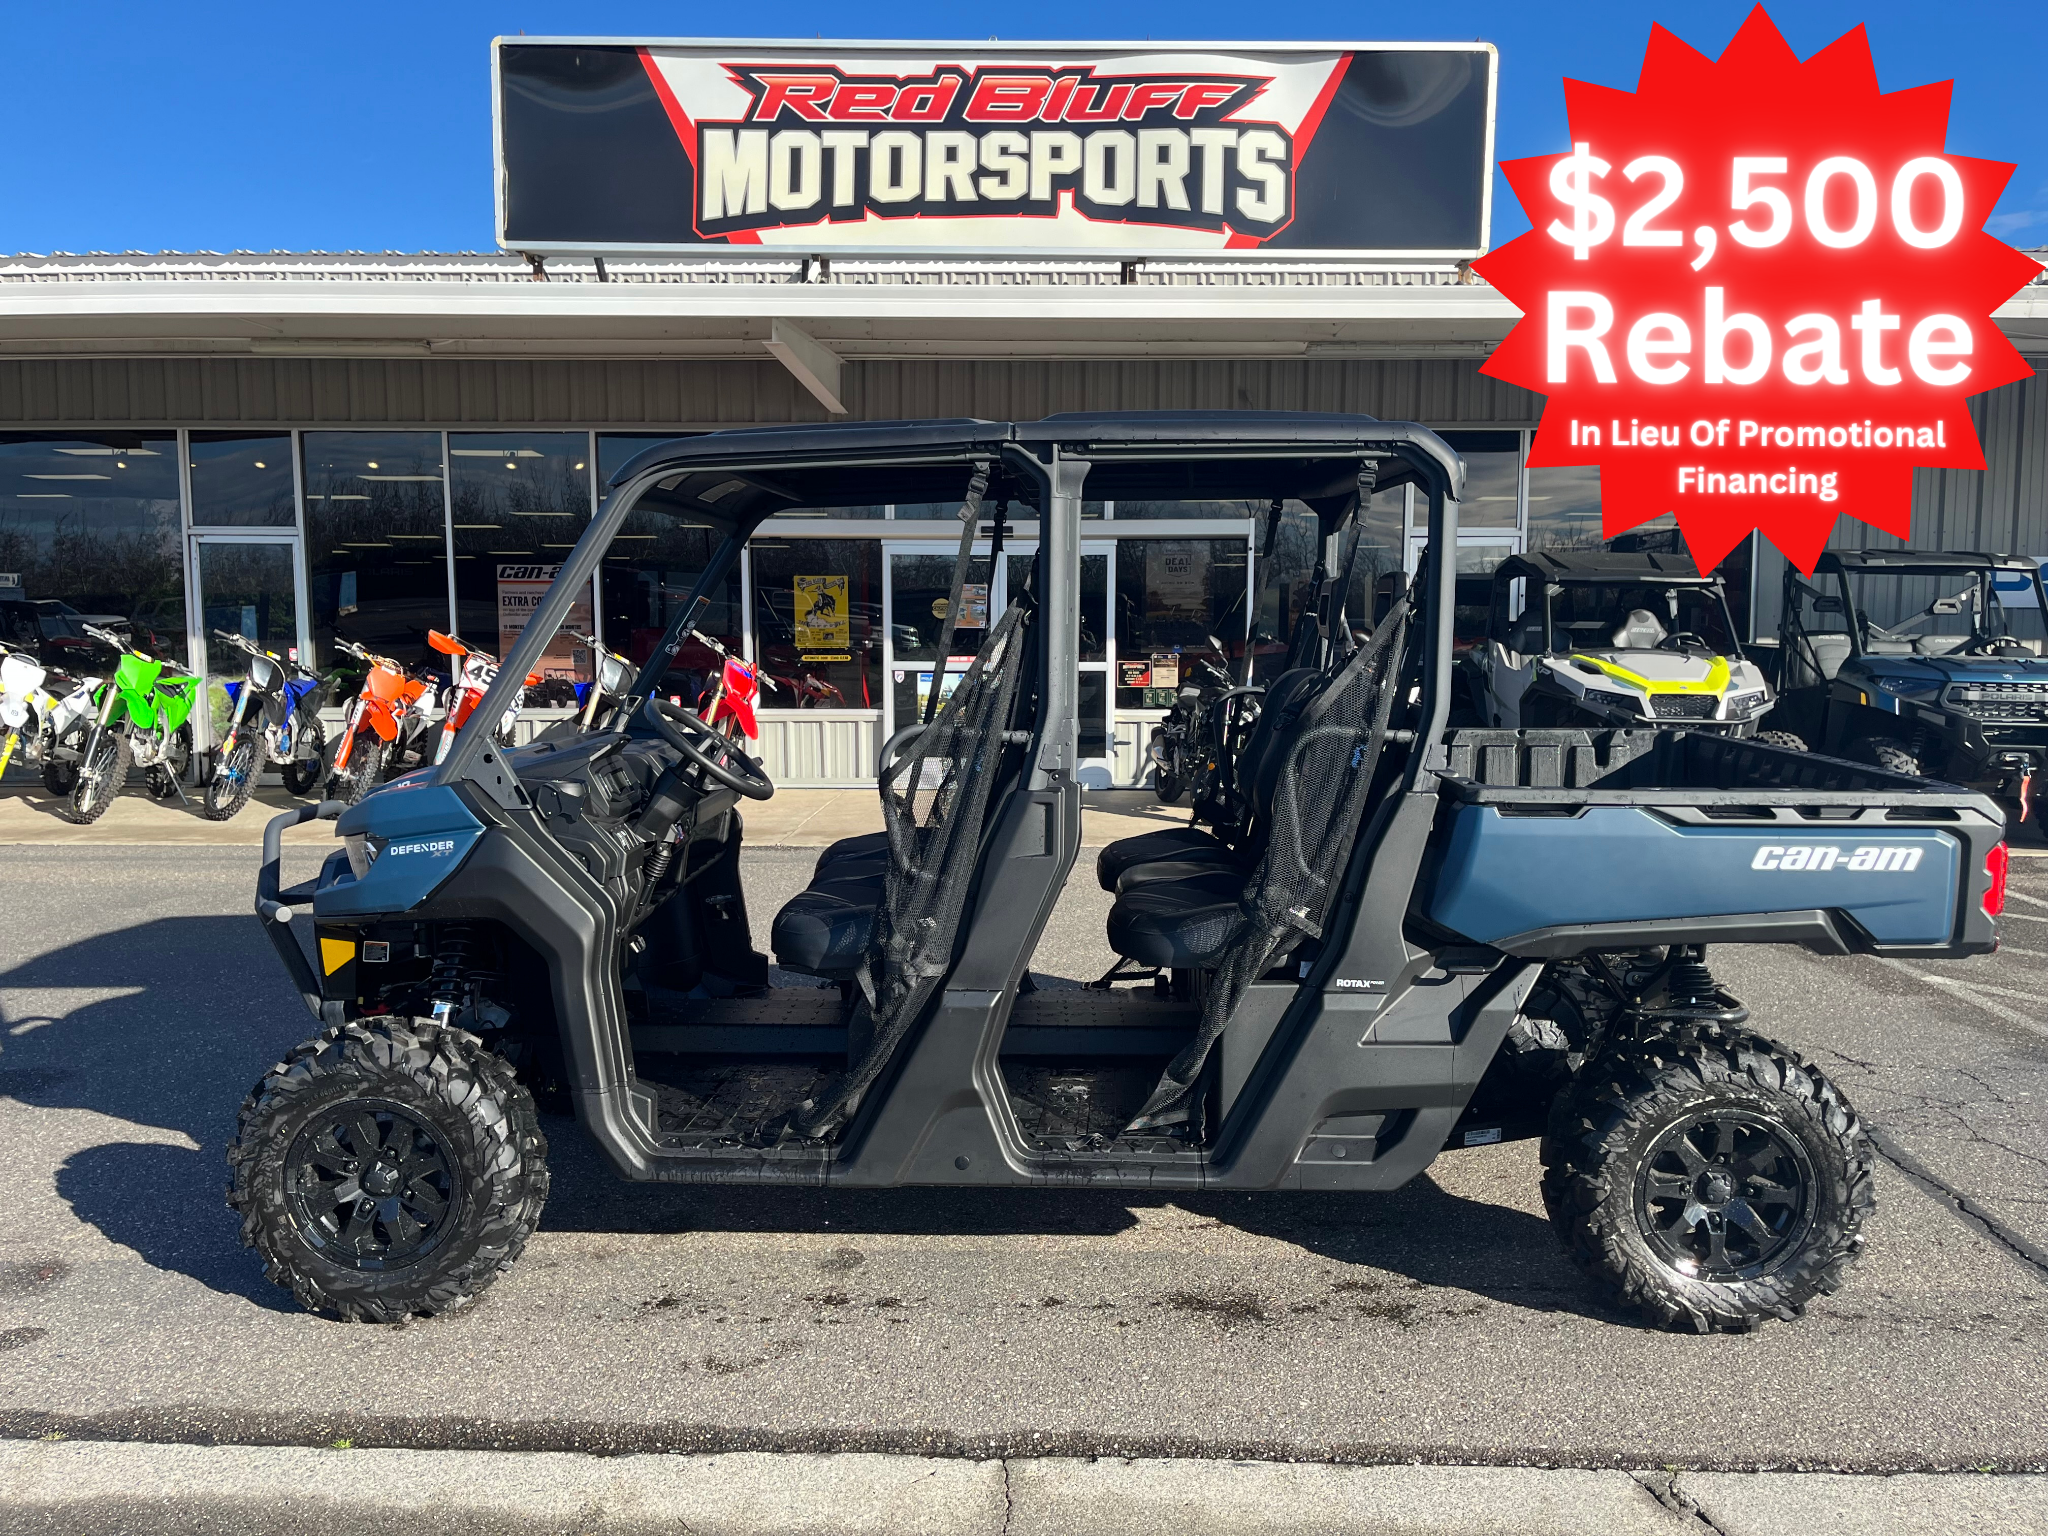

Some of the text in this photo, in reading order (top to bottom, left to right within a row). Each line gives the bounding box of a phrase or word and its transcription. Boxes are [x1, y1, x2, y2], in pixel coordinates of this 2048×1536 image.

[751, 74, 962, 121] Red
[702, 127, 1288, 224] MOTORSPORTS
[1165, 557, 1191, 566] DEAL
[499, 566, 562, 579] can-a
[502, 596, 543, 606] EXTRA CO
[390, 841, 455, 856] DEFENDER
[431, 850, 454, 858] XT
[1751, 846, 1924, 871] can-am
[1336, 979, 1371, 989] ROTAX
